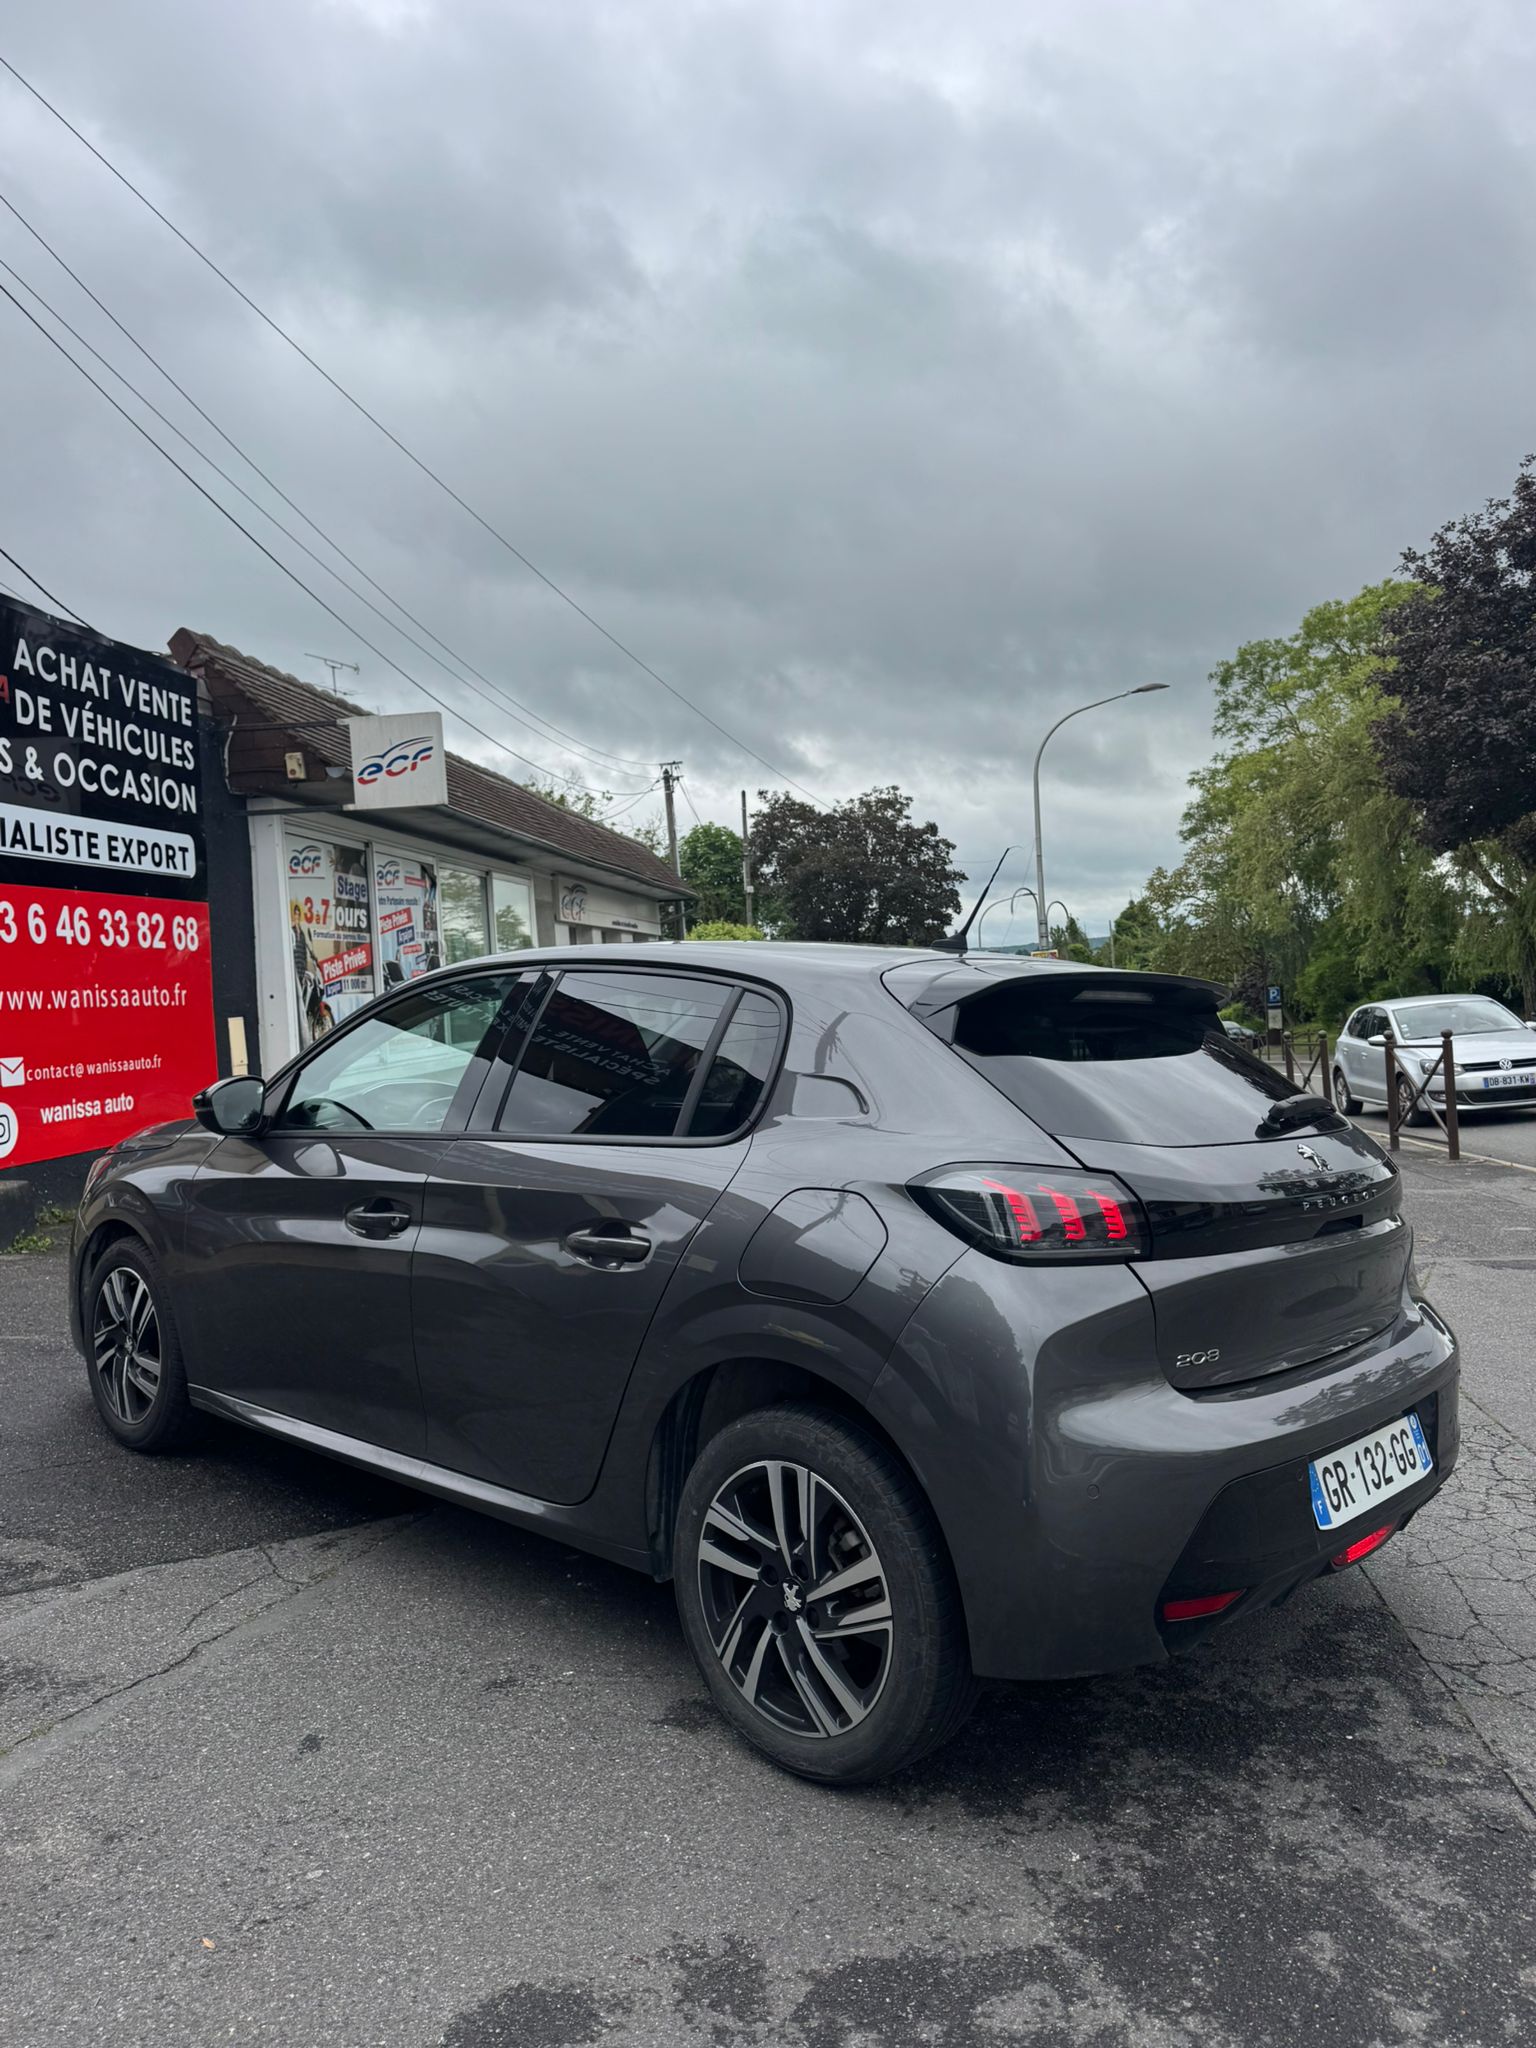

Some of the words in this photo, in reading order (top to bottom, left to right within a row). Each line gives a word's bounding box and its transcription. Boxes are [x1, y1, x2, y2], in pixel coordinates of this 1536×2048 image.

[13, 638, 111, 700] ACHAT
[118, 674, 192, 727] VENTE
[15, 688, 52, 732] DE
[60, 701, 195, 770] VÉHICULES
[25, 746, 44, 781] &
[54, 752, 197, 814] OCCASION
[107, 835, 190, 872] EXPORT
[337, 876, 368, 900] Stage
[304, 896, 314, 926] 3
[321, 898, 331, 926] 7
[28, 903, 47, 945] 6
[56, 905, 91, 946] 46
[98, 908, 130, 948] 33
[137, 911, 167, 949] 82
[172, 915, 199, 952] 68
[323, 959, 344, 981] Piste
[343, 949, 368, 972] Privée
[0, 983, 188, 1011] ww.wanissaauto.fr
[87, 1054, 162, 1077] wanissaauto.fr
[40, 1098, 102, 1125] wanissa
[104, 1092, 134, 1114] auto
[1303, 1189, 1378, 1212] PEUGEOT
[1176, 1348, 1220, 1368] 208
[1322, 1428, 1417, 1513] GR-132-GG
